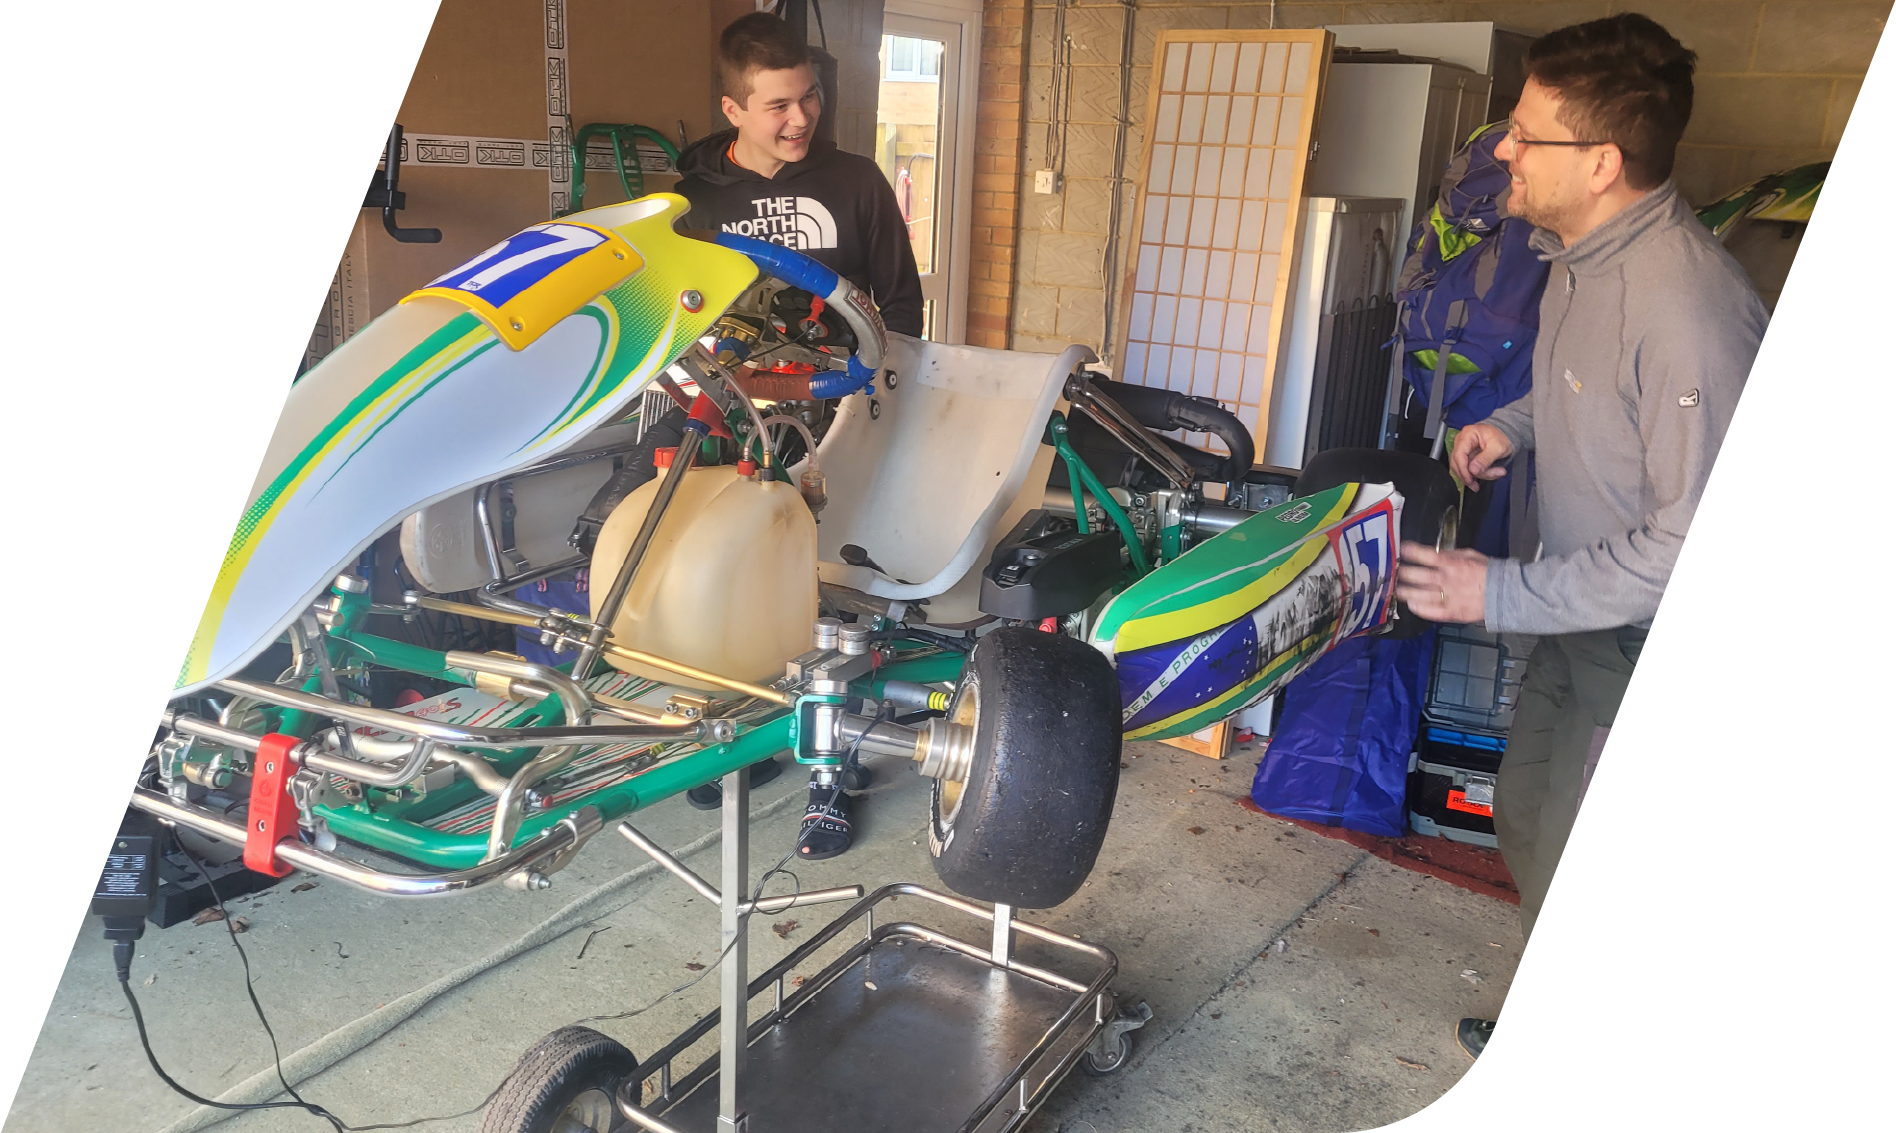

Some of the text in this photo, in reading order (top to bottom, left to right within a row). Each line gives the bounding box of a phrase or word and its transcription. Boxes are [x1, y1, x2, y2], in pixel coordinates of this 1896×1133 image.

[420, 146, 468, 161] OTK
[480, 149, 524, 163] OTK
[751, 196, 795, 217] THE
[721, 214, 797, 237] NORTH
[345, 253, 353, 289] ITALY
[1343, 513, 1389, 638] 57
[1158, 677, 1169, 688] E
[804, 804, 847, 818] OMMY
